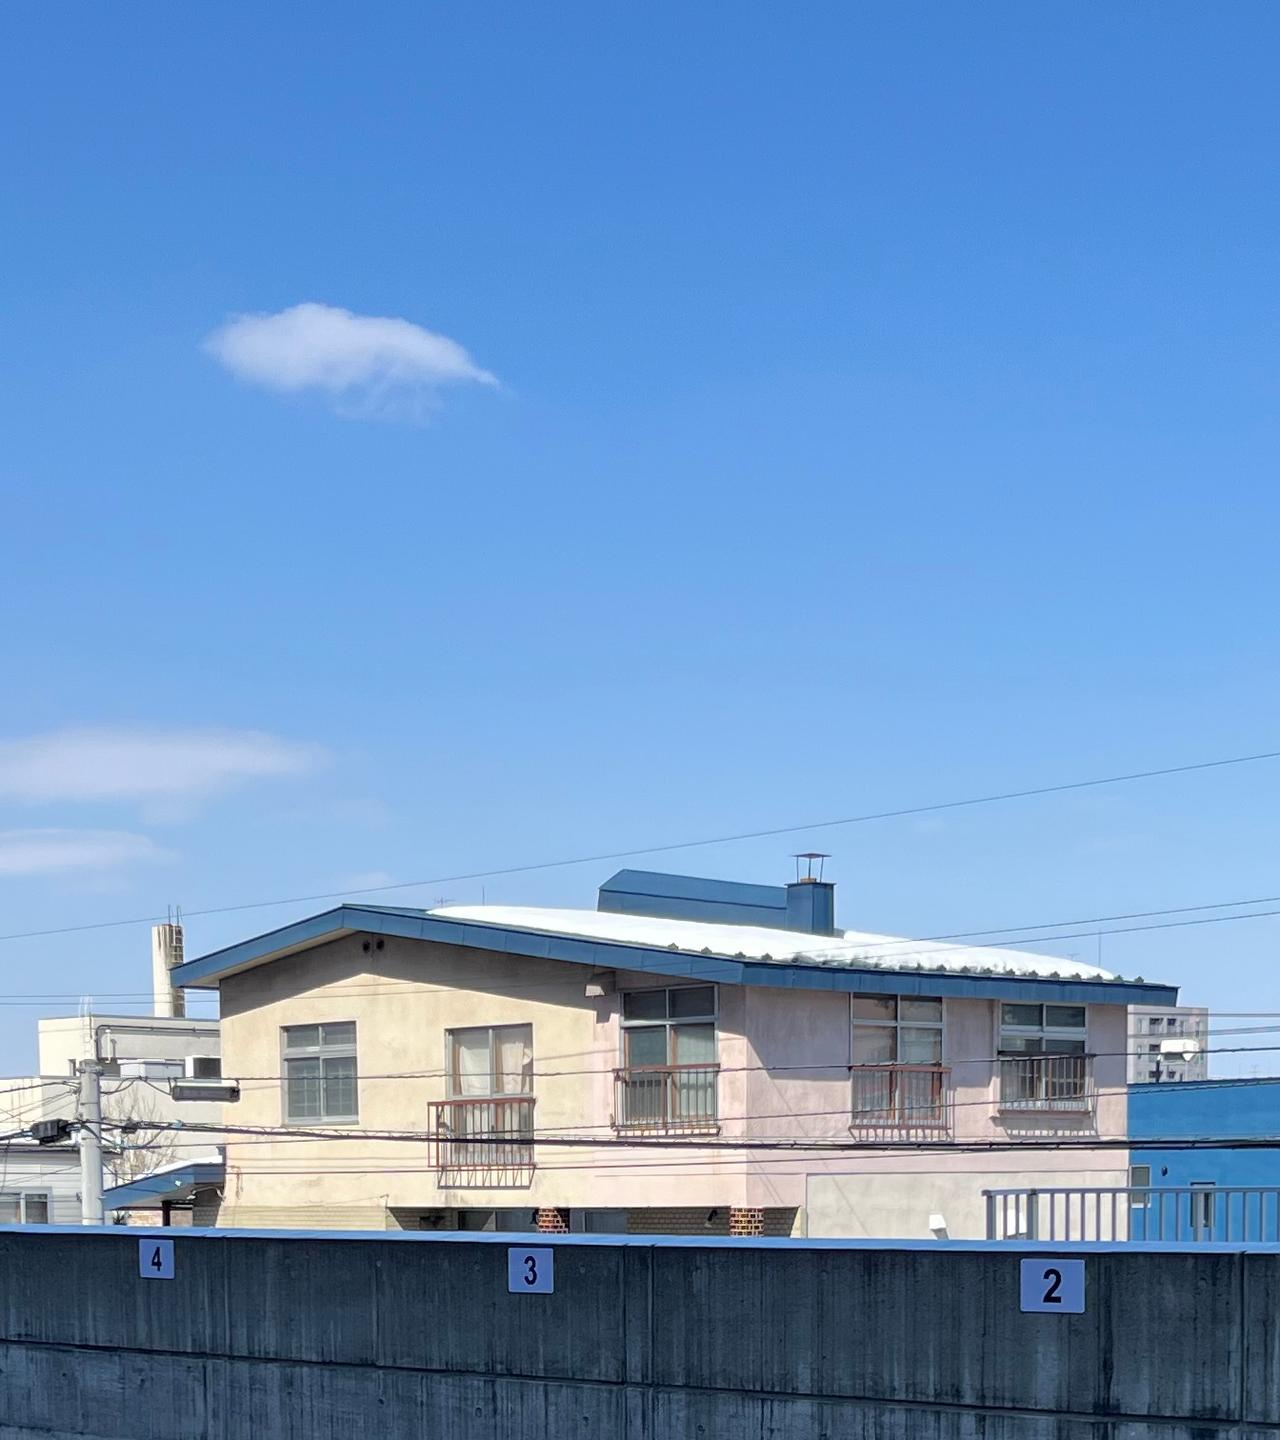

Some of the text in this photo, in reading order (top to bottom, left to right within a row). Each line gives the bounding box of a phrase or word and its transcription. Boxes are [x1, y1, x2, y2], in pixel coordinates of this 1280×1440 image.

[151, 1246, 162, 1272] 4
[524, 1255, 537, 1286] 3
[1042, 1268, 1062, 1304] 2
